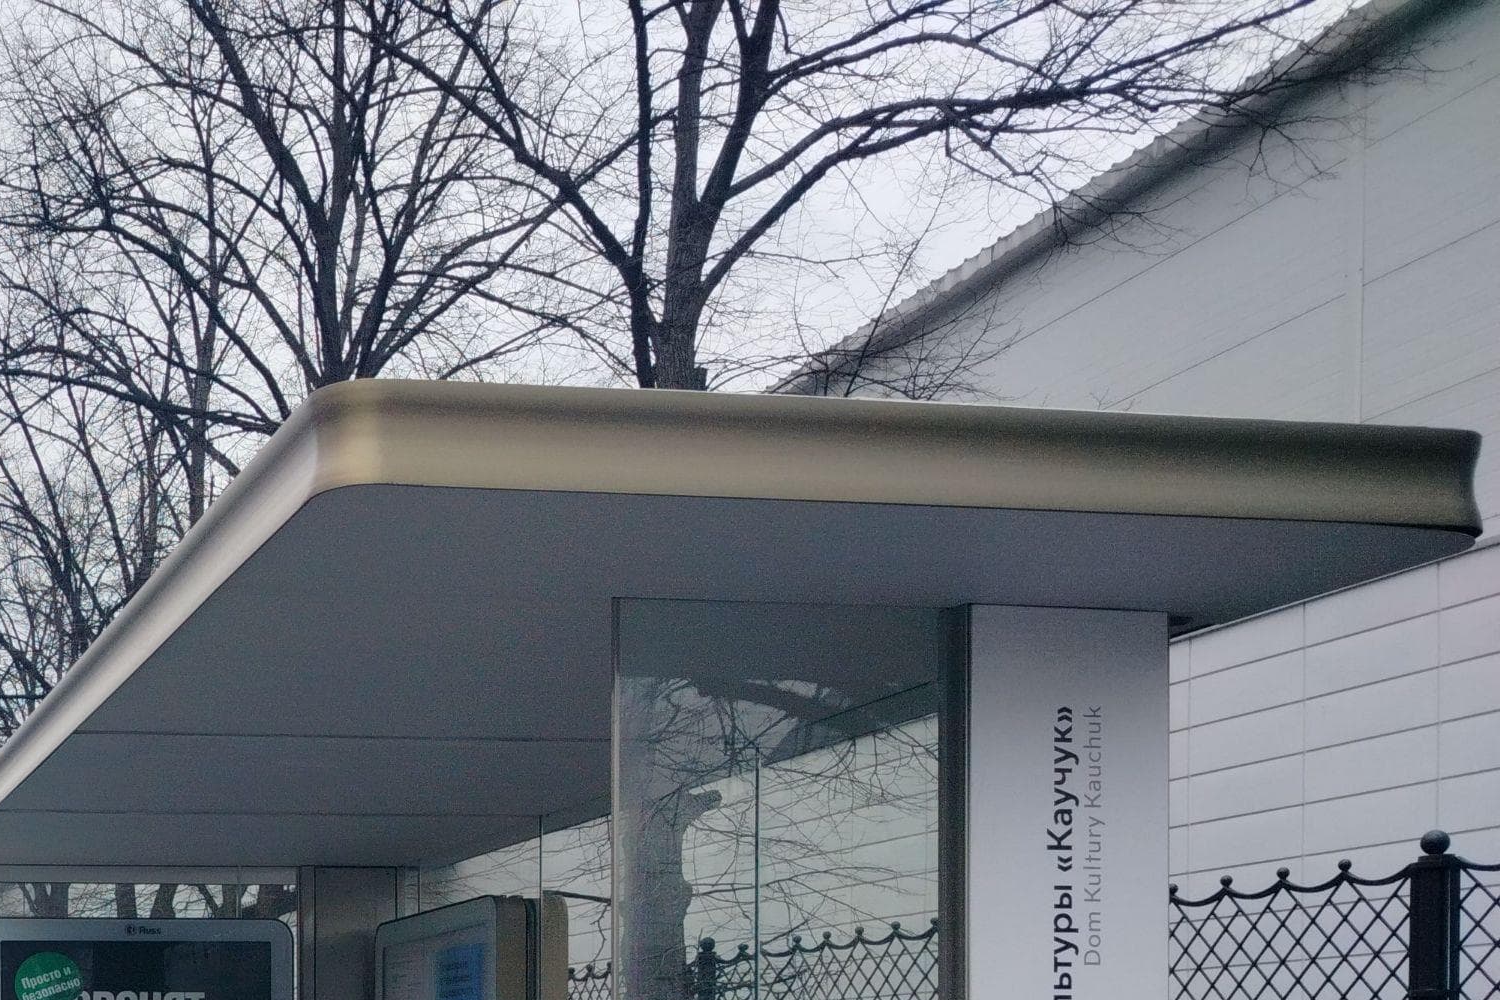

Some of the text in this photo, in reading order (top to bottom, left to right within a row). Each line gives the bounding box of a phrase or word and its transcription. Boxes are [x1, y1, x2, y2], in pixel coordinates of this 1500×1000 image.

[1046, 705, 1079, 873] «Каучук»
[1083, 704, 1106, 967] Dom Kultury Kauchuk
[21, 966, 72, 989] Просто и
